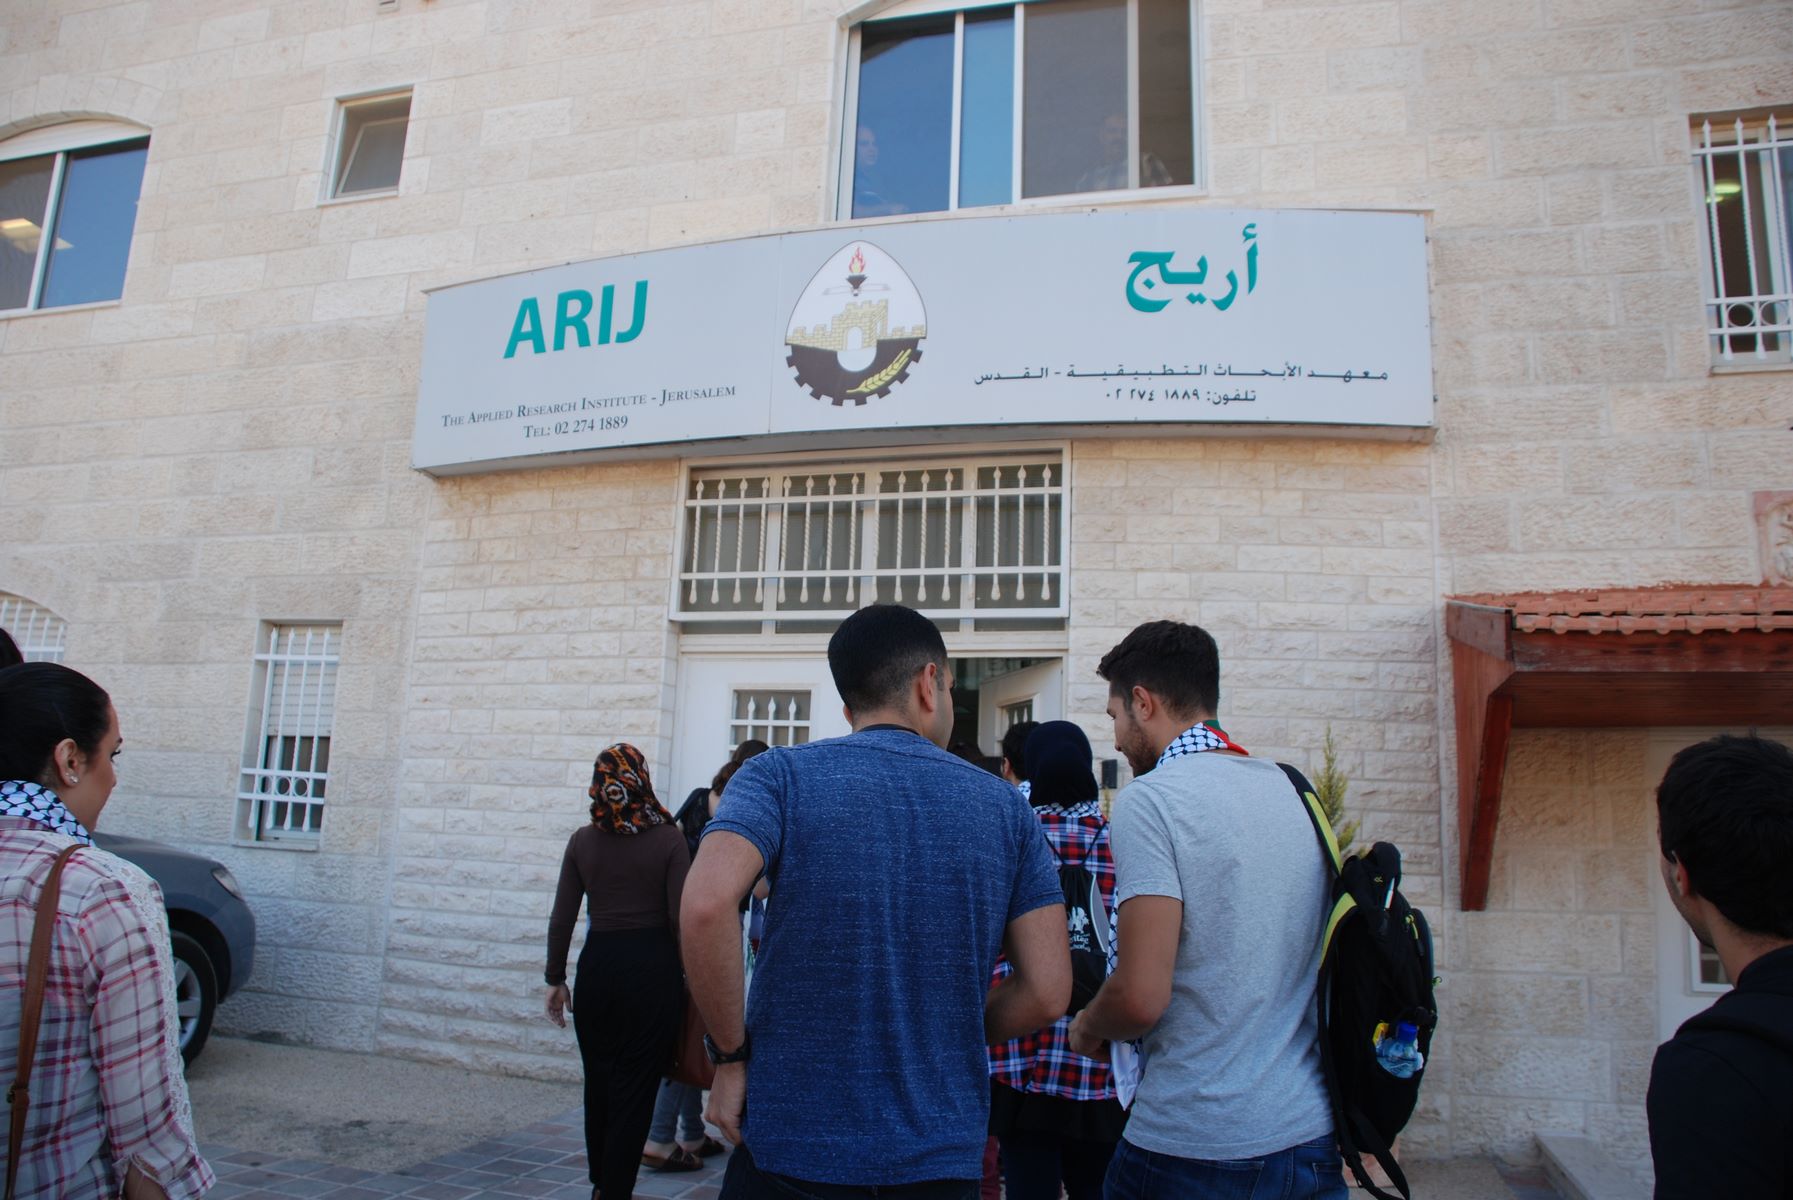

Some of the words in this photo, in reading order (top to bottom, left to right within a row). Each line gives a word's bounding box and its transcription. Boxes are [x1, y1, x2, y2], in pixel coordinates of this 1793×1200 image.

[1126, 223, 1258, 312] أريج
[503, 280, 648, 359] ARIJ
[974, 367, 1049, 385] القدس
[1307, 369, 1388, 383] معهد
[1165, 387, 1200, 401] ١٨٨٩
[554, 421, 568, 435] 02
[573, 417, 594, 433] 274
[599, 415, 628, 430] 1889
